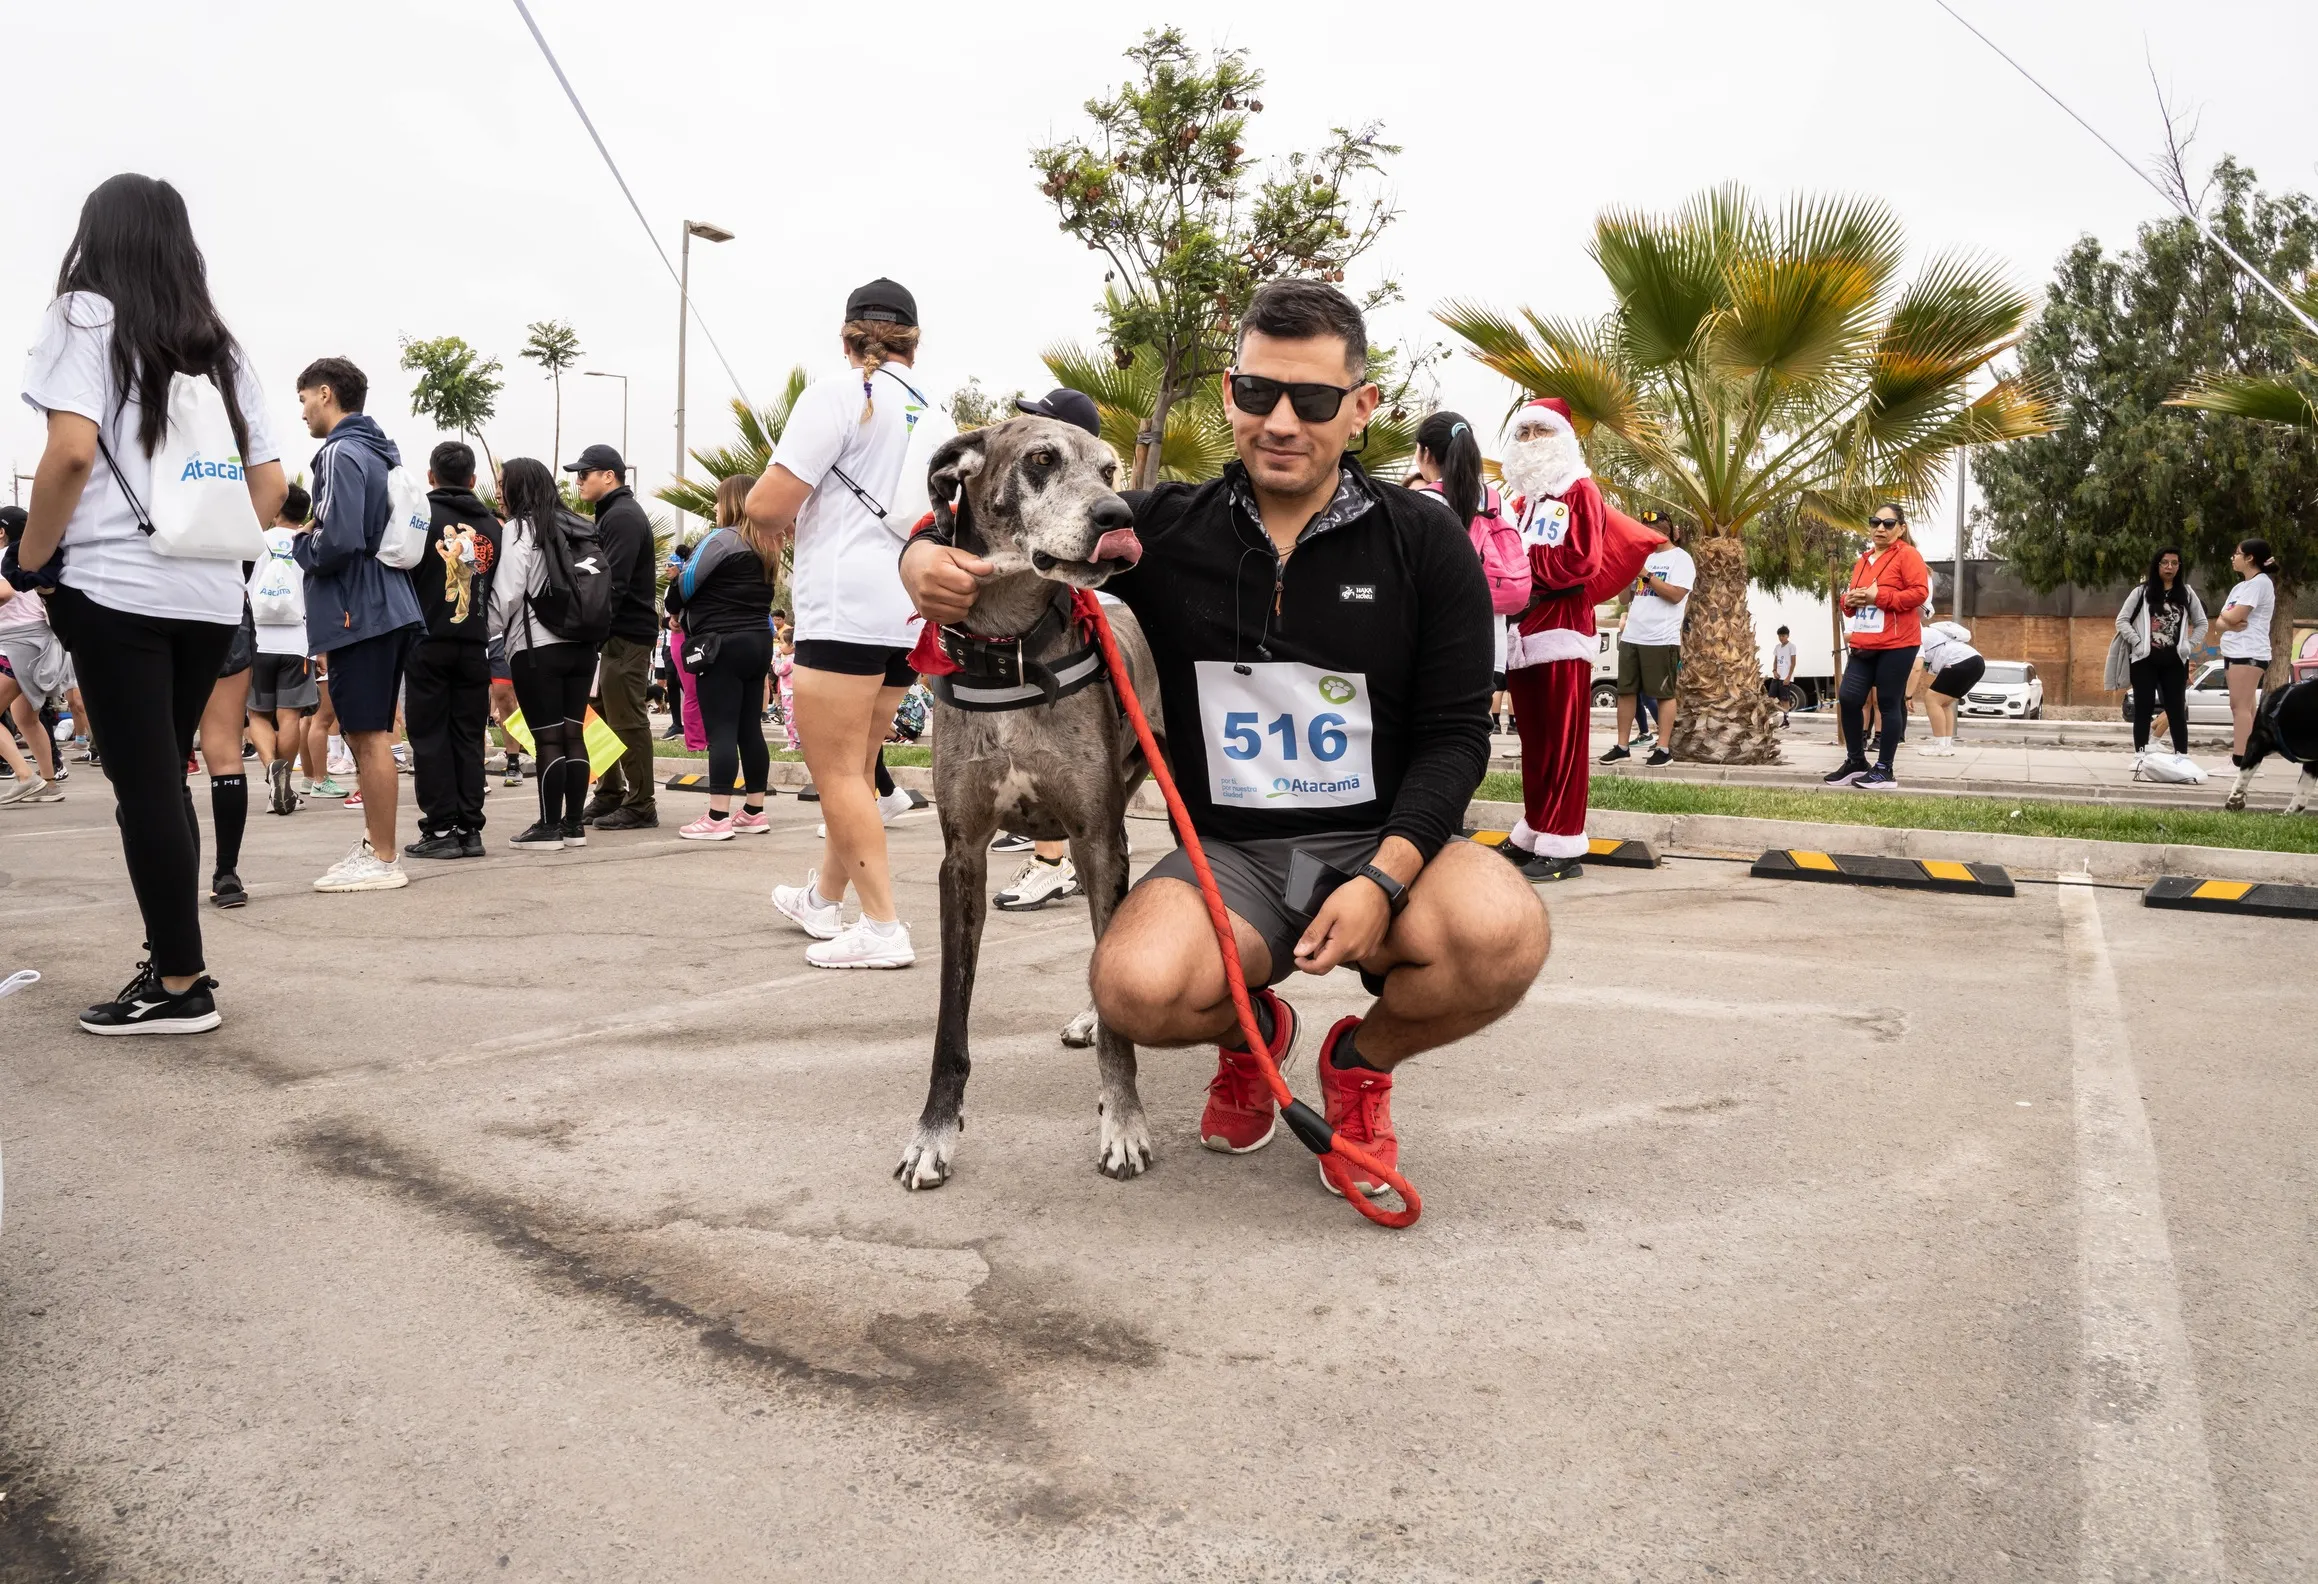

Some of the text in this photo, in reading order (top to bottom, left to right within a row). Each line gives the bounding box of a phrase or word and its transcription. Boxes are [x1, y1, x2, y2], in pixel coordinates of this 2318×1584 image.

[1555, 507, 1565, 517] D
[1529, 517, 1560, 541] 15
[1222, 711, 1348, 762] 516
[1291, 777, 1361, 793] Atacama
[1222, 790, 1243, 799] ciudad
